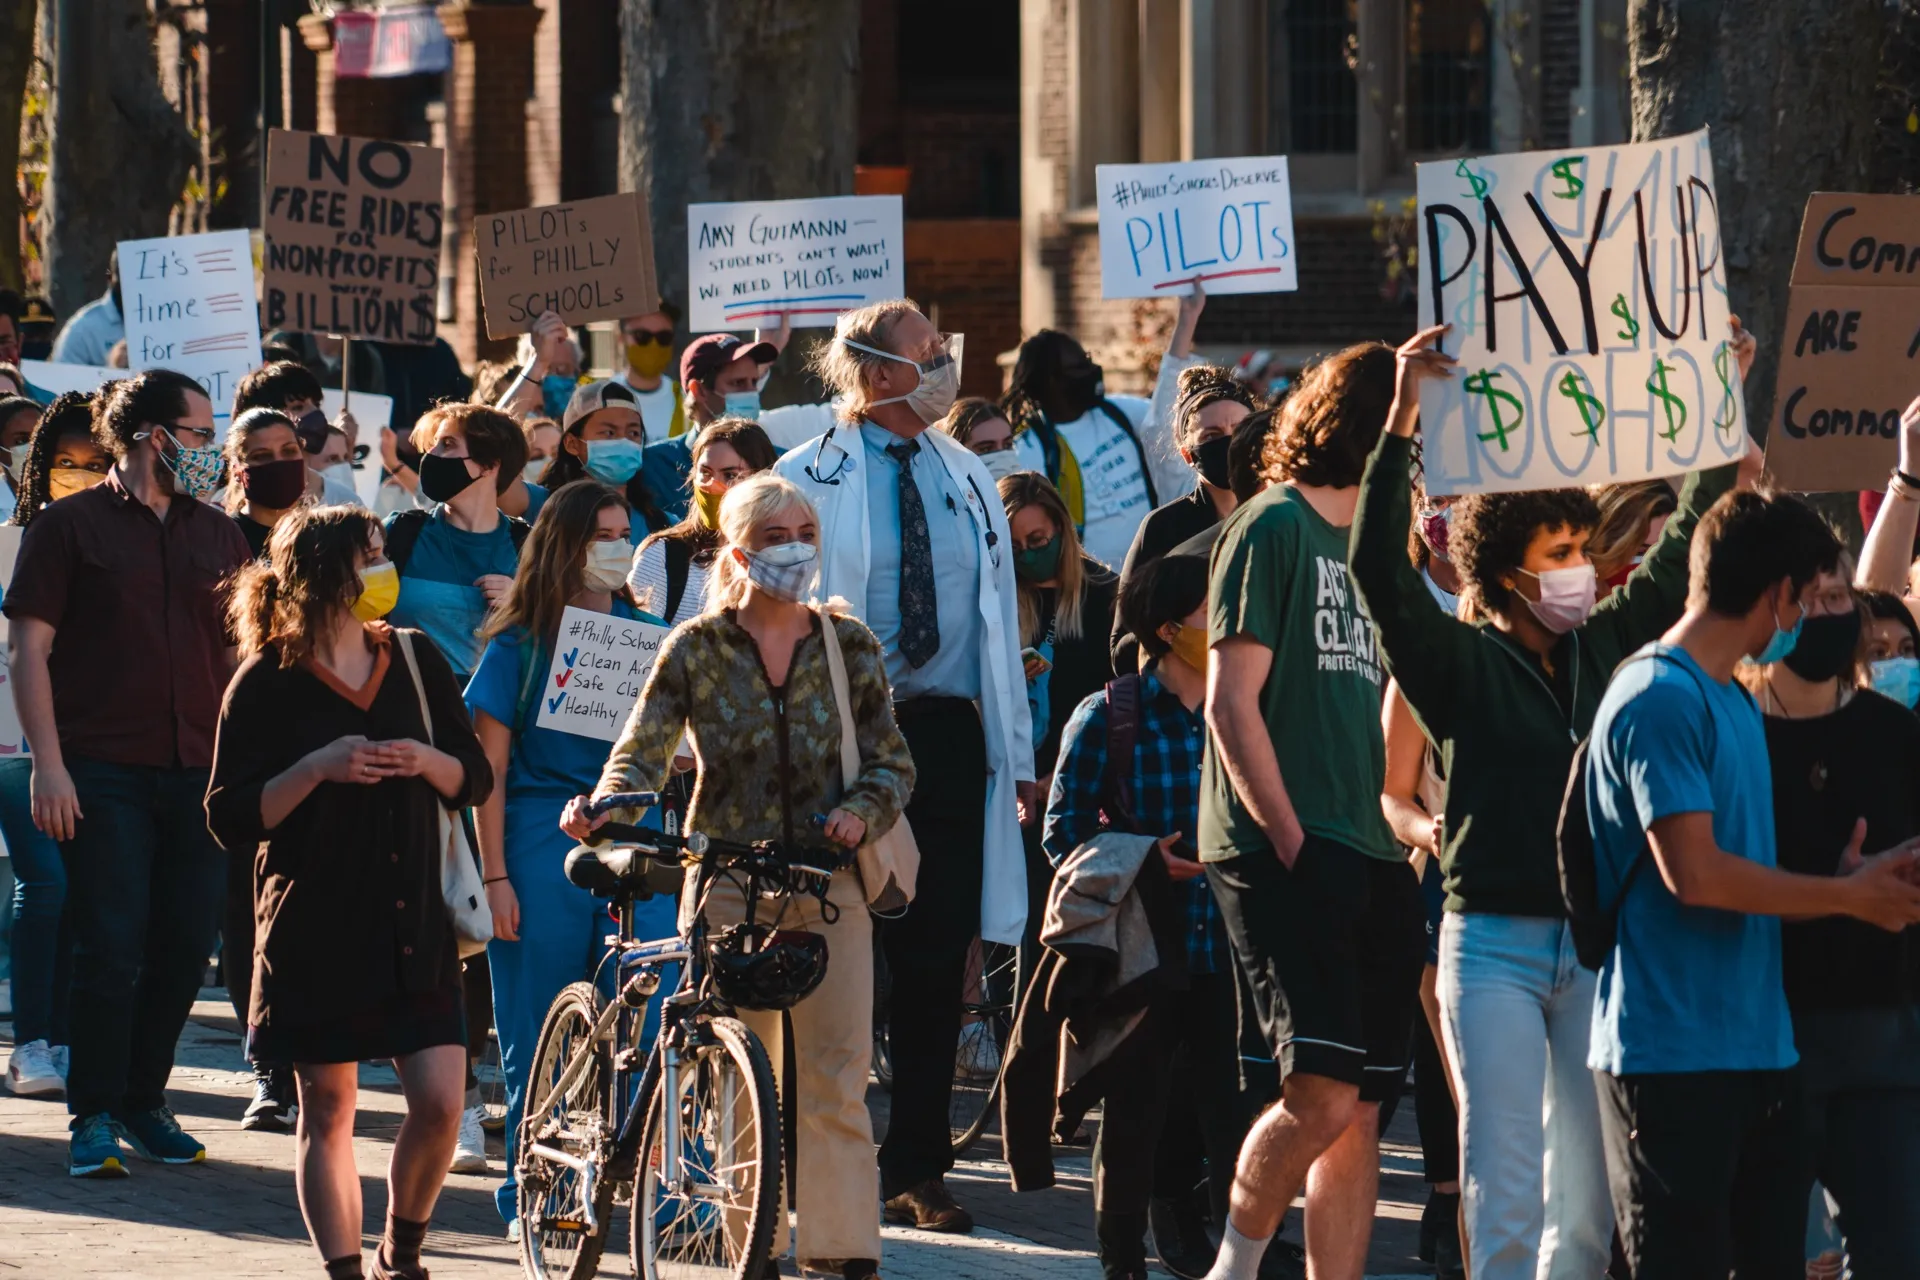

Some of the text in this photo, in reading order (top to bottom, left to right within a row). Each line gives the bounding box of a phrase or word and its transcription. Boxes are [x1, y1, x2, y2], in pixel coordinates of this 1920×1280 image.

[308, 135, 411, 189] NO
[269, 186, 443, 249] FREE RIDES
[492, 208, 587, 247] PILOTs
[699, 214, 847, 249] AMY GUTMANN
[336, 232, 377, 249] FOR
[709, 239, 886, 273] STUDENTS CAN'T WAIT!
[135, 249, 188, 280] It's
[488, 238, 620, 280] for PHILLY
[1425, 175, 1720, 355] PAY UP
[699, 284, 720, 300] WE
[733, 278, 770, 296] NEED
[853, 259, 890, 283] NOW!
[133, 293, 200, 323] time
[268, 289, 437, 344] BILLION$
[140, 335, 176, 362] for
[1795, 310, 1861, 357] ARE
[1784, 386, 1900, 439] Commo
[569, 620, 662, 652] #Philly School
[579, 652, 652, 676] Clean Air
[574, 673, 639, 697] Safe Cla
[565, 696, 618, 728] Healthy
